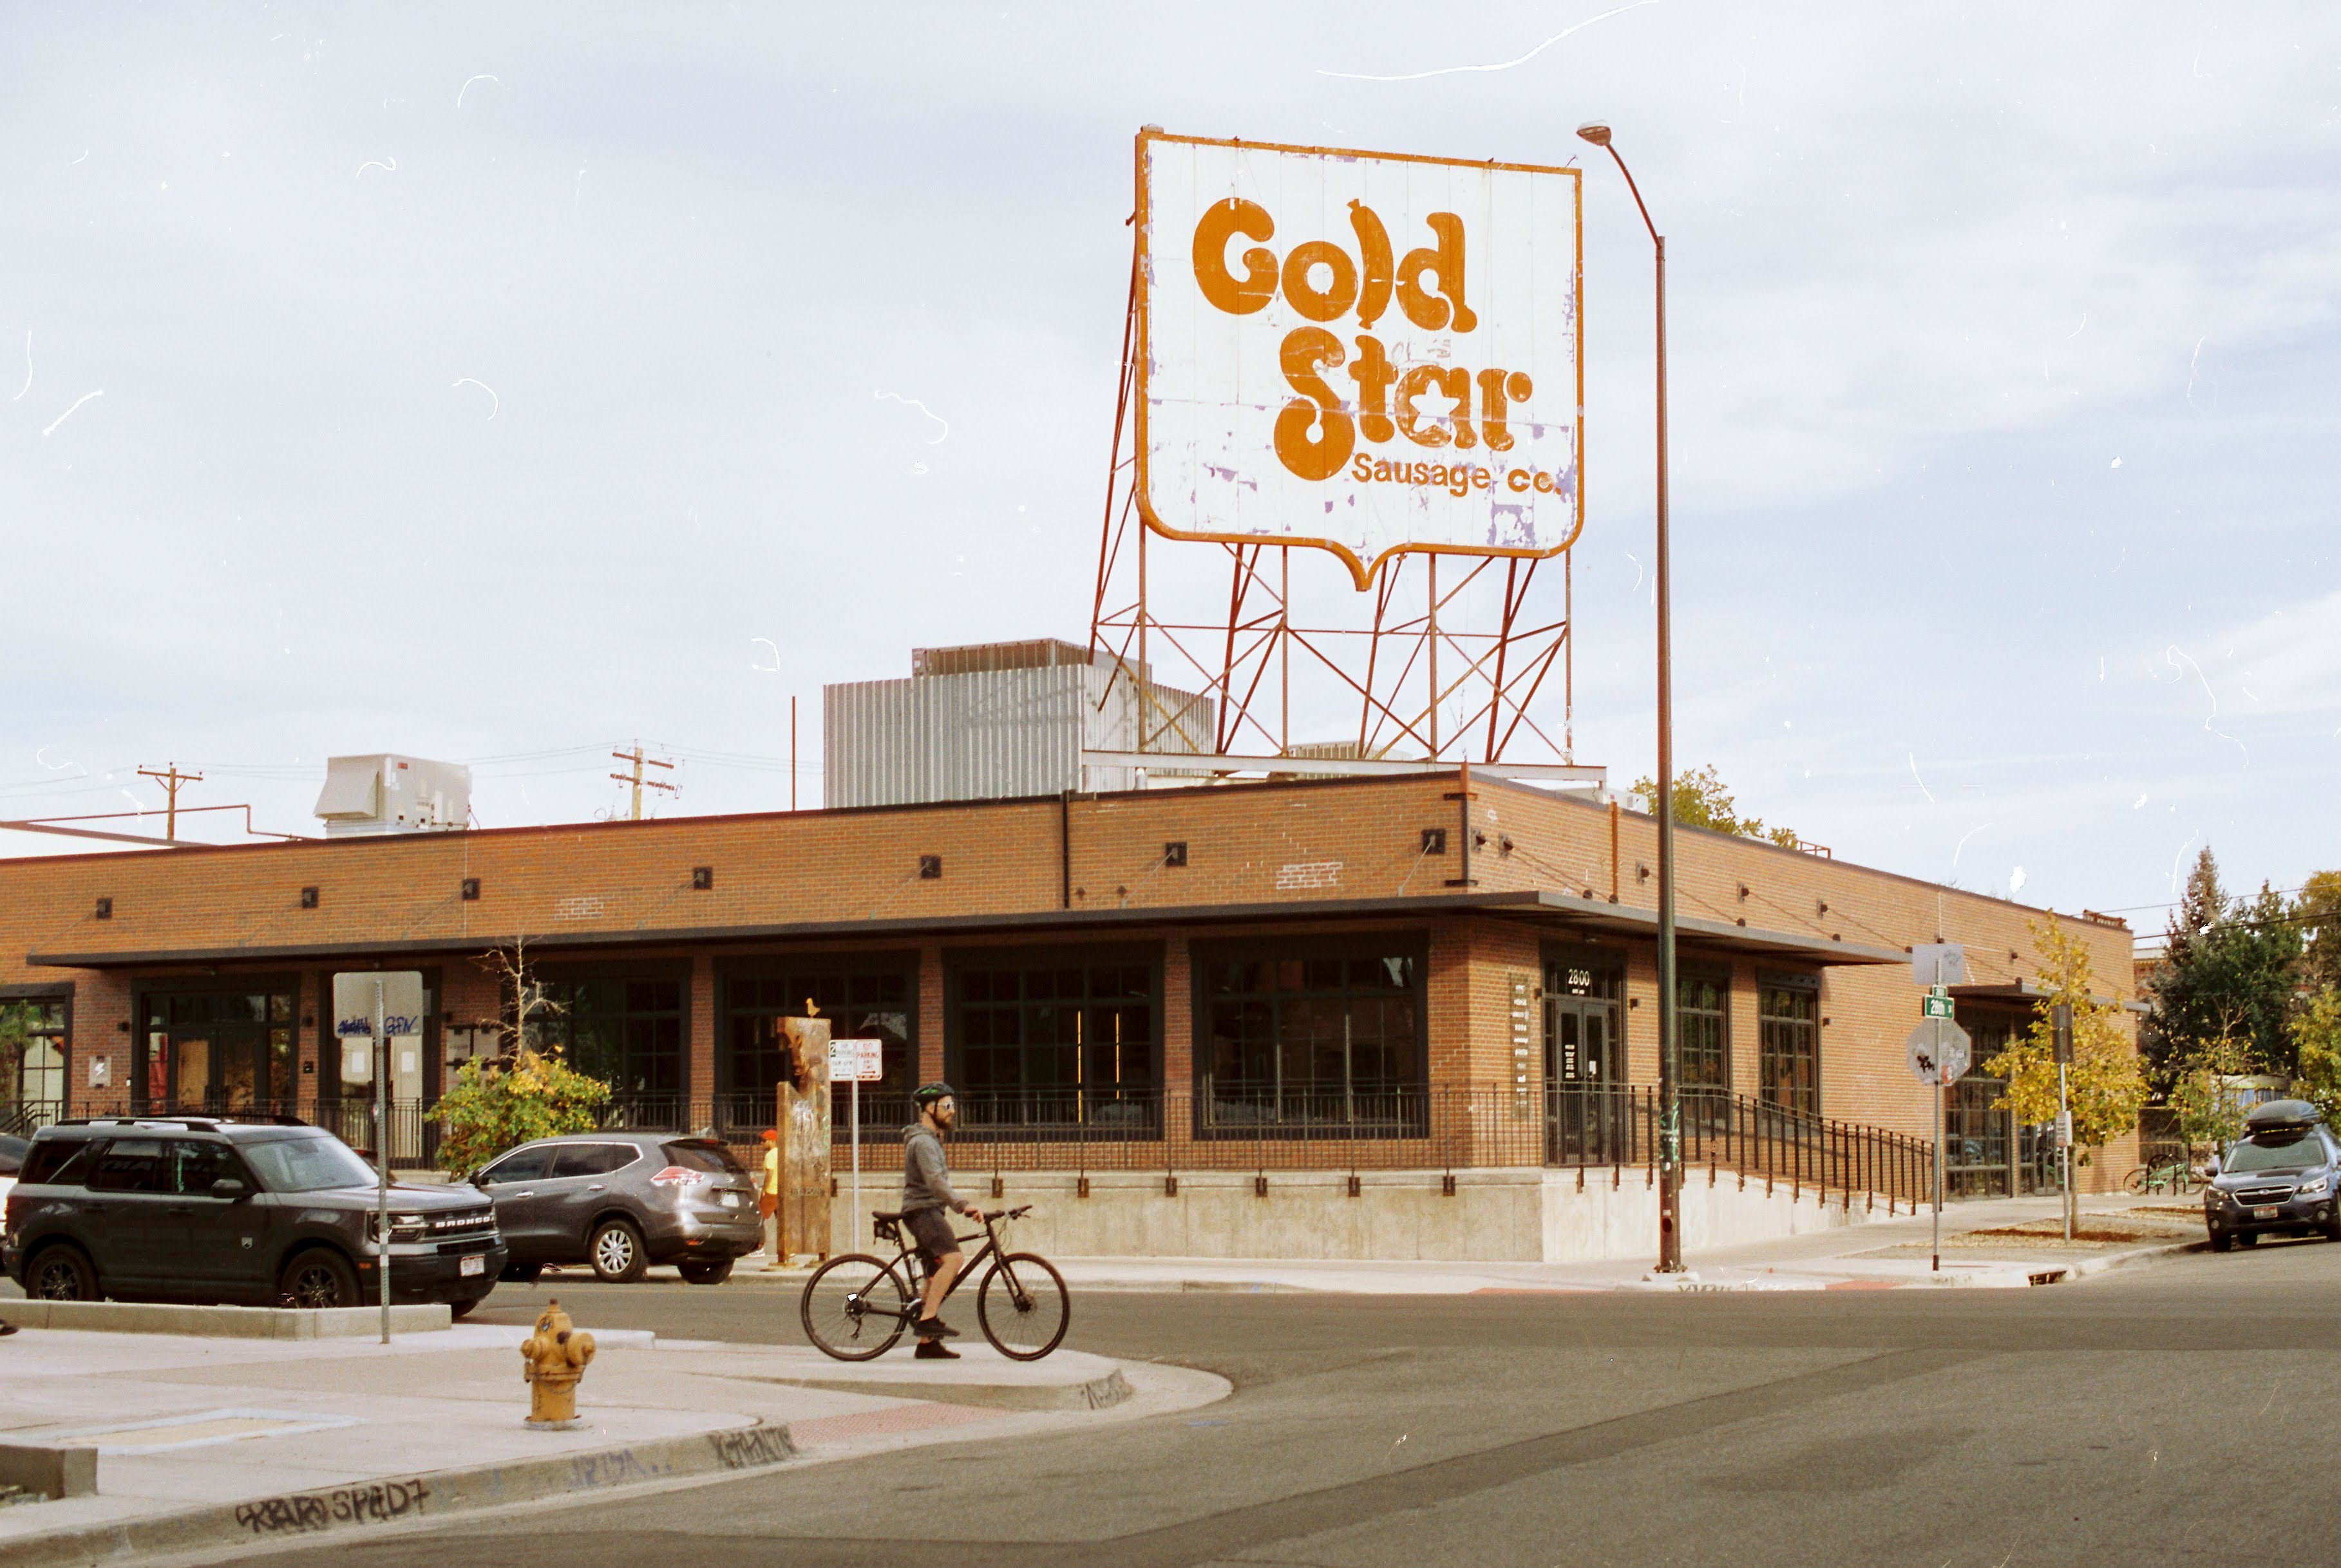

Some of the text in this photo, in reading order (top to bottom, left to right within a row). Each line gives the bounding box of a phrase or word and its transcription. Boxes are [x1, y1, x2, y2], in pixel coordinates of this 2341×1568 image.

[1192, 198, 1477, 333] Gold
[1274, 326, 1533, 481] Star
[1352, 453, 1490, 497] Sausage
[1568, 968, 1590, 987] 2800
[435, 1216, 490, 1228] BRONCO
